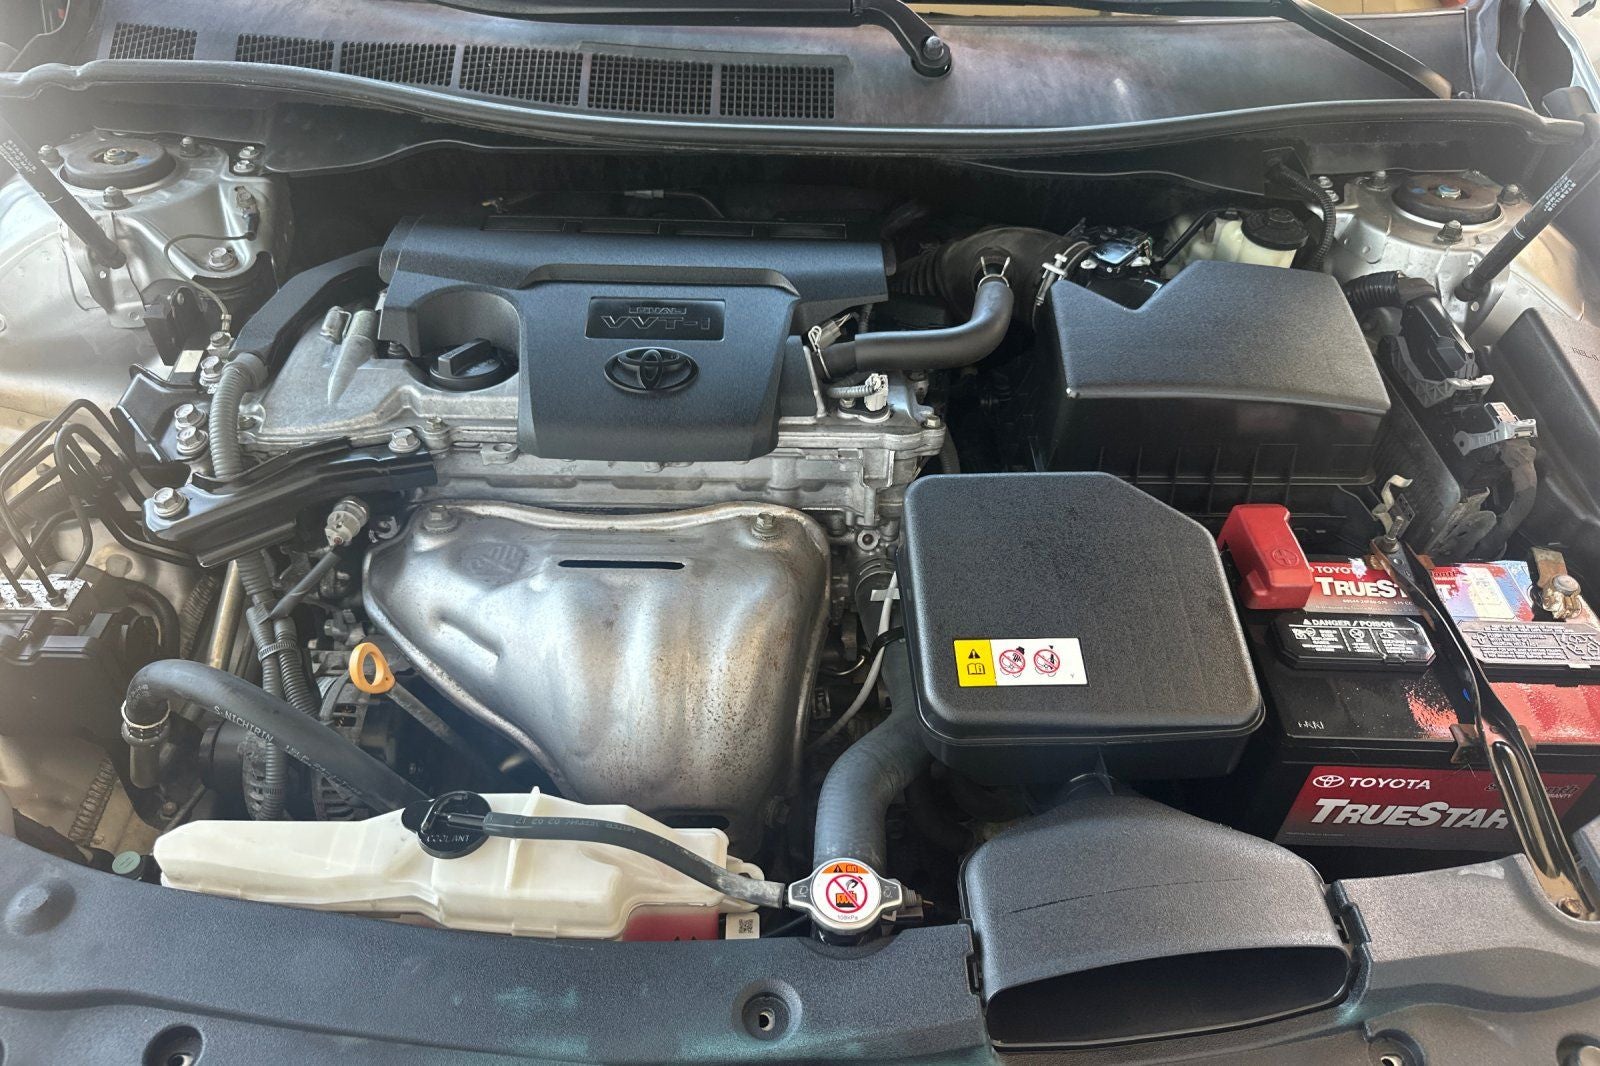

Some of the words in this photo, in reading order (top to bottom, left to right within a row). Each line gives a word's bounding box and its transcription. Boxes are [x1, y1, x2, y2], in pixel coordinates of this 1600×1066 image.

[1312, 619, 1351, 627] DANGER
[1359, 620, 1395, 628] POISON
[1348, 776, 1431, 790] TOYOTA
